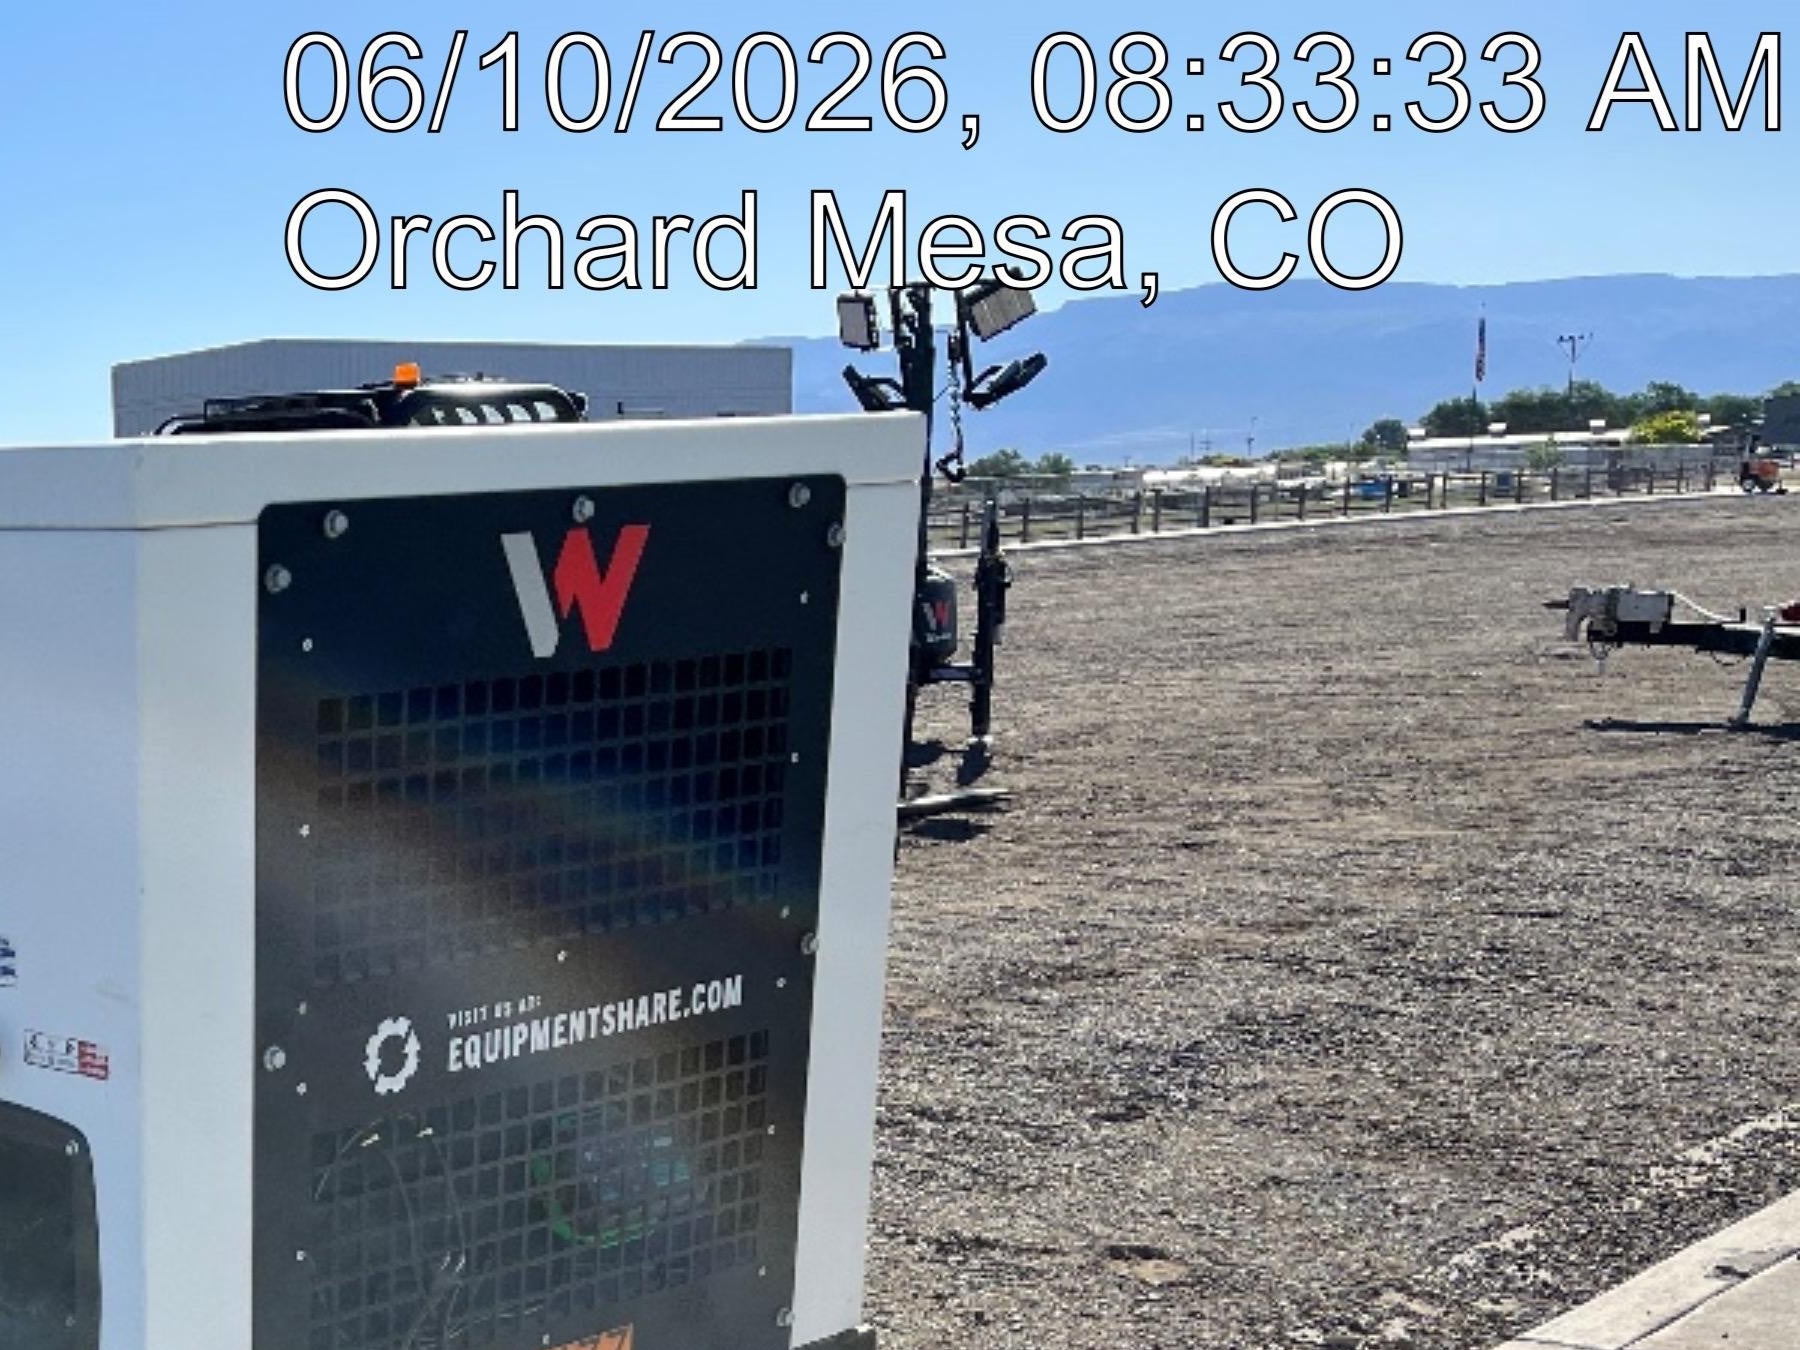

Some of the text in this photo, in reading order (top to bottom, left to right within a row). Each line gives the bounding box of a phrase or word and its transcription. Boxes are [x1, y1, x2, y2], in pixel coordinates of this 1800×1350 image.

[447, 1004, 487, 1030] VISIT
[494, 1001, 512, 1018] US
[447, 974, 744, 1072] EQUIPMENTSHARE.COM
